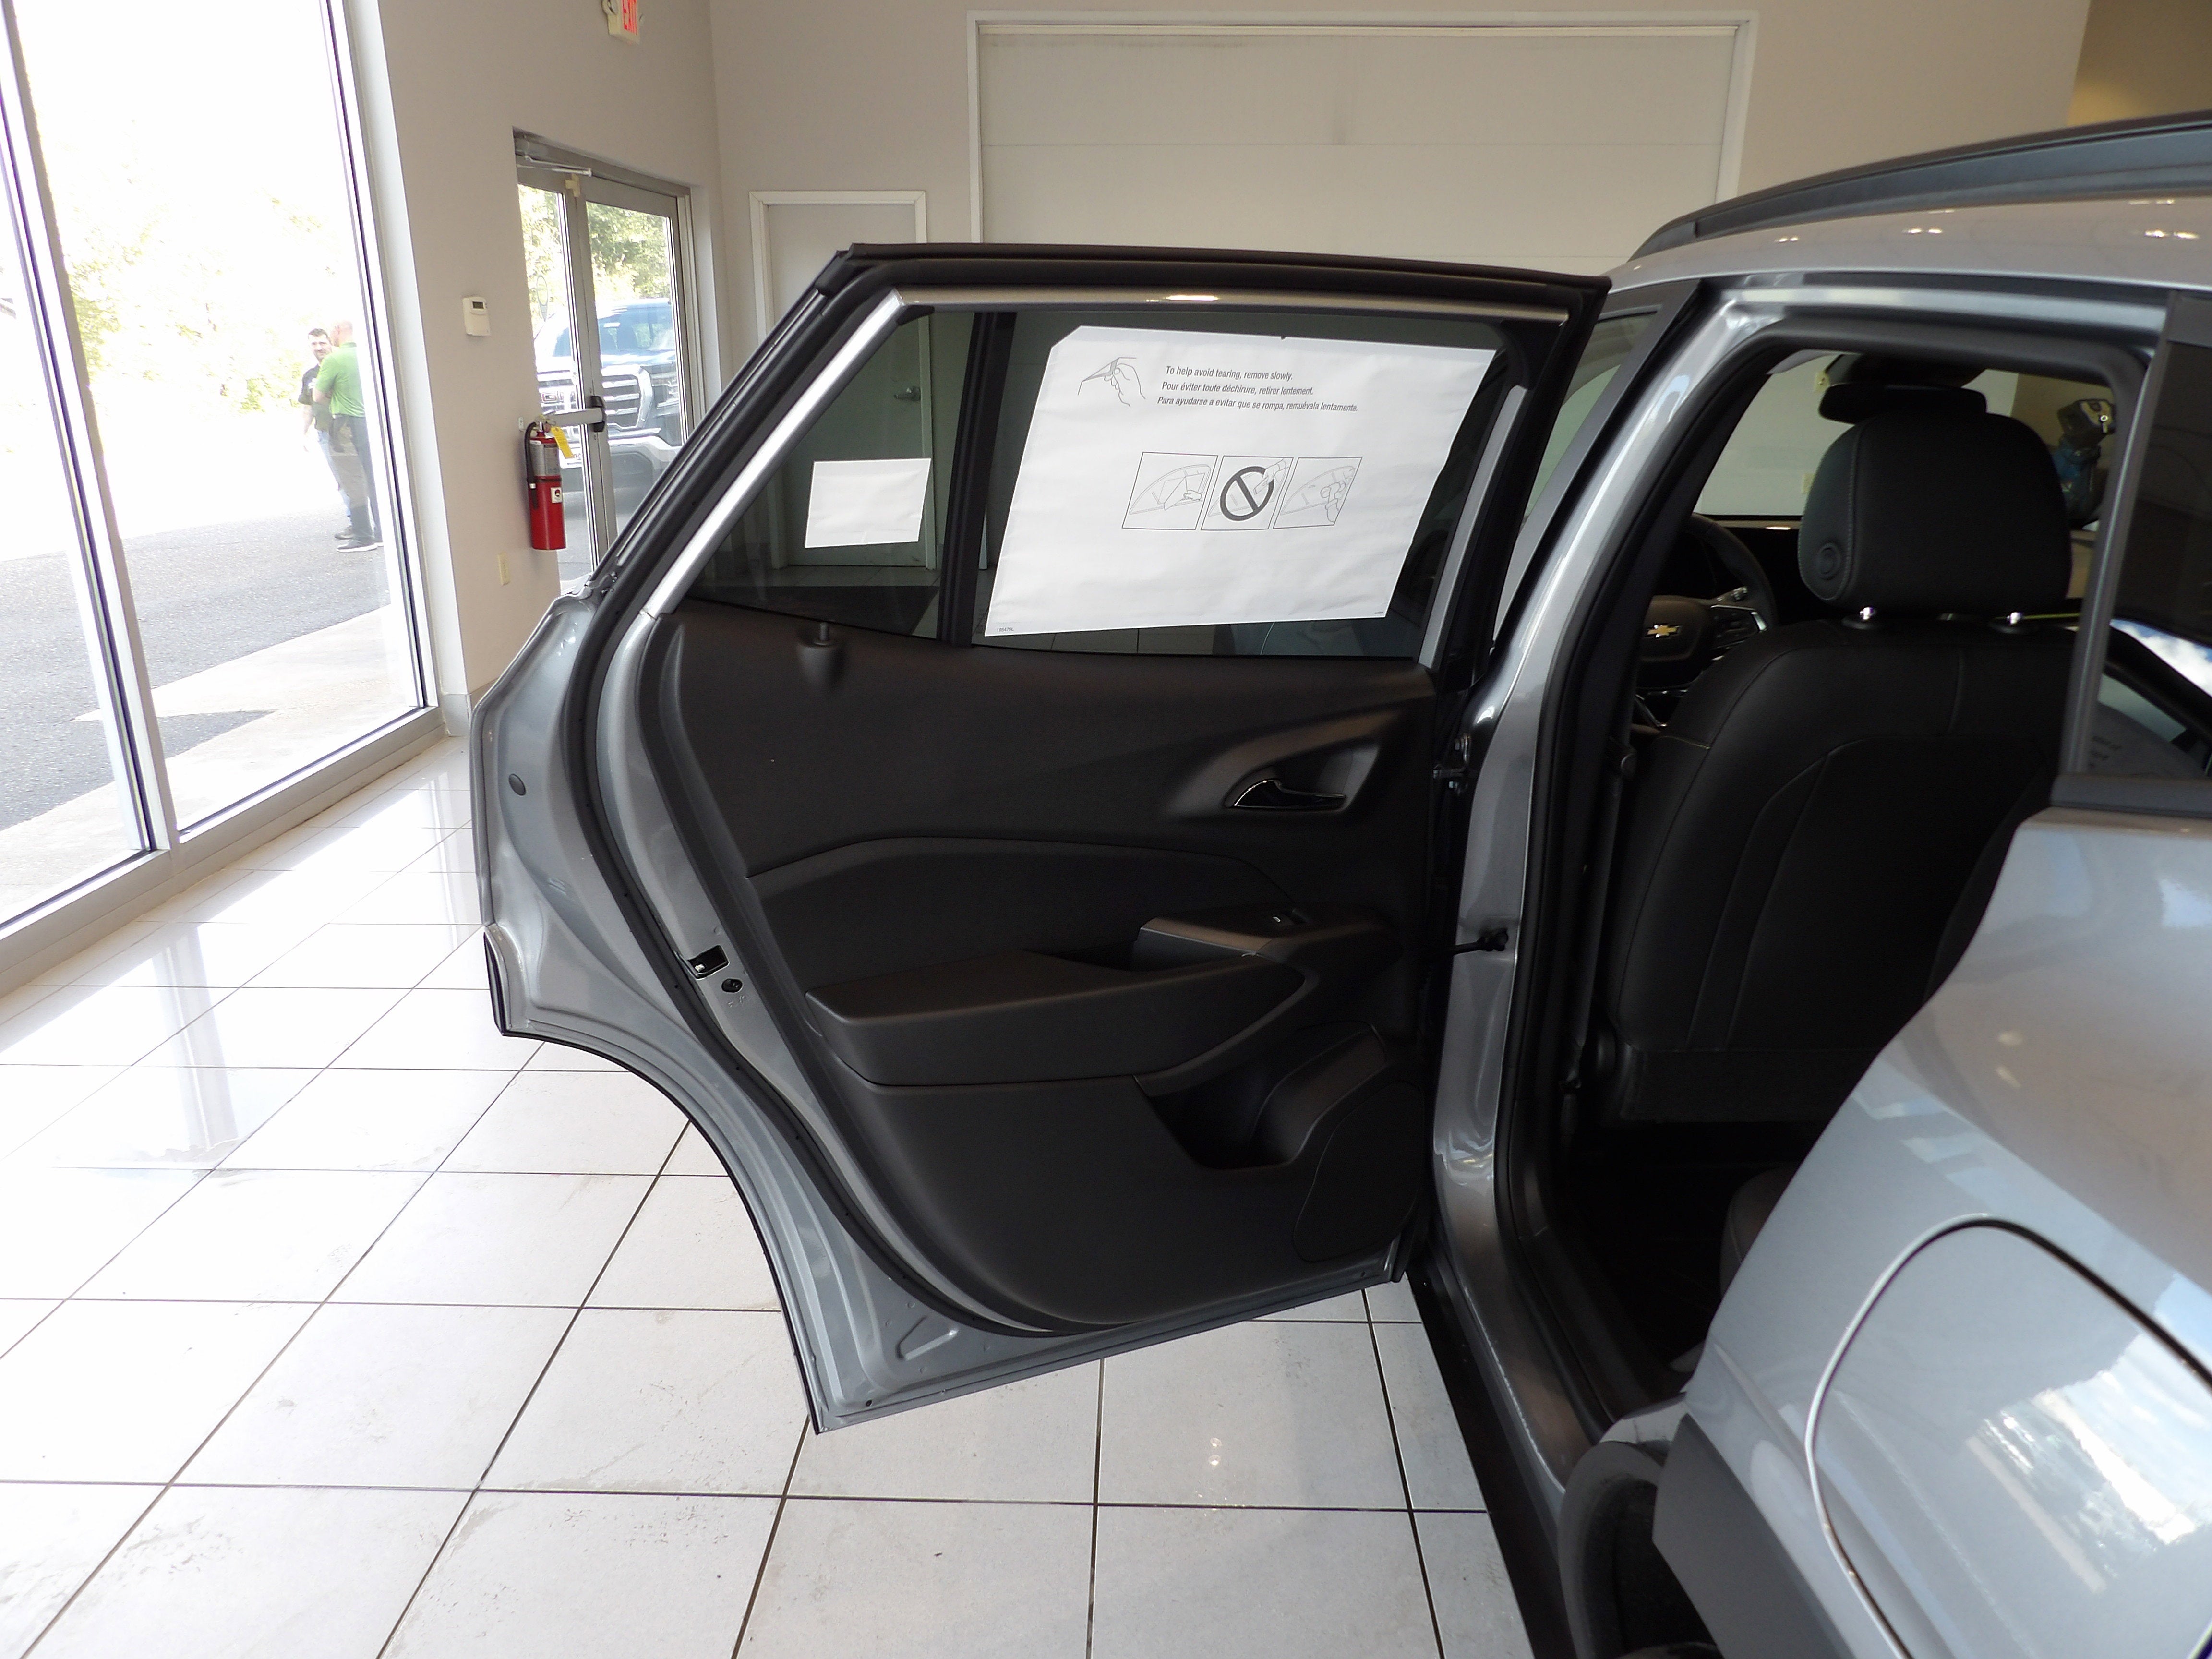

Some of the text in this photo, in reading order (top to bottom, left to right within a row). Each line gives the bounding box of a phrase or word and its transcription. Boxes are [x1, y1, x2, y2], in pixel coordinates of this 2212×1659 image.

[1166, 366, 1174, 374] To
[1177, 366, 1192, 377] help
[1194, 368, 1214, 377] avoid
[1216, 369, 1242, 380] tearing,
[1270, 372, 1293, 382] slowly.
[1162, 381, 1313, 395] Pour éviter toute déchirure, retirer lentement.
[1157, 396, 1174, 405] Para
[1175, 397, 1208, 406] ayudarse
[1215, 398, 1236, 407] evitar
[1262, 403, 1284, 411] rompa,
[1286, 401, 1319, 410] remuévala
[1321, 402, 1358, 412] lentamente.
